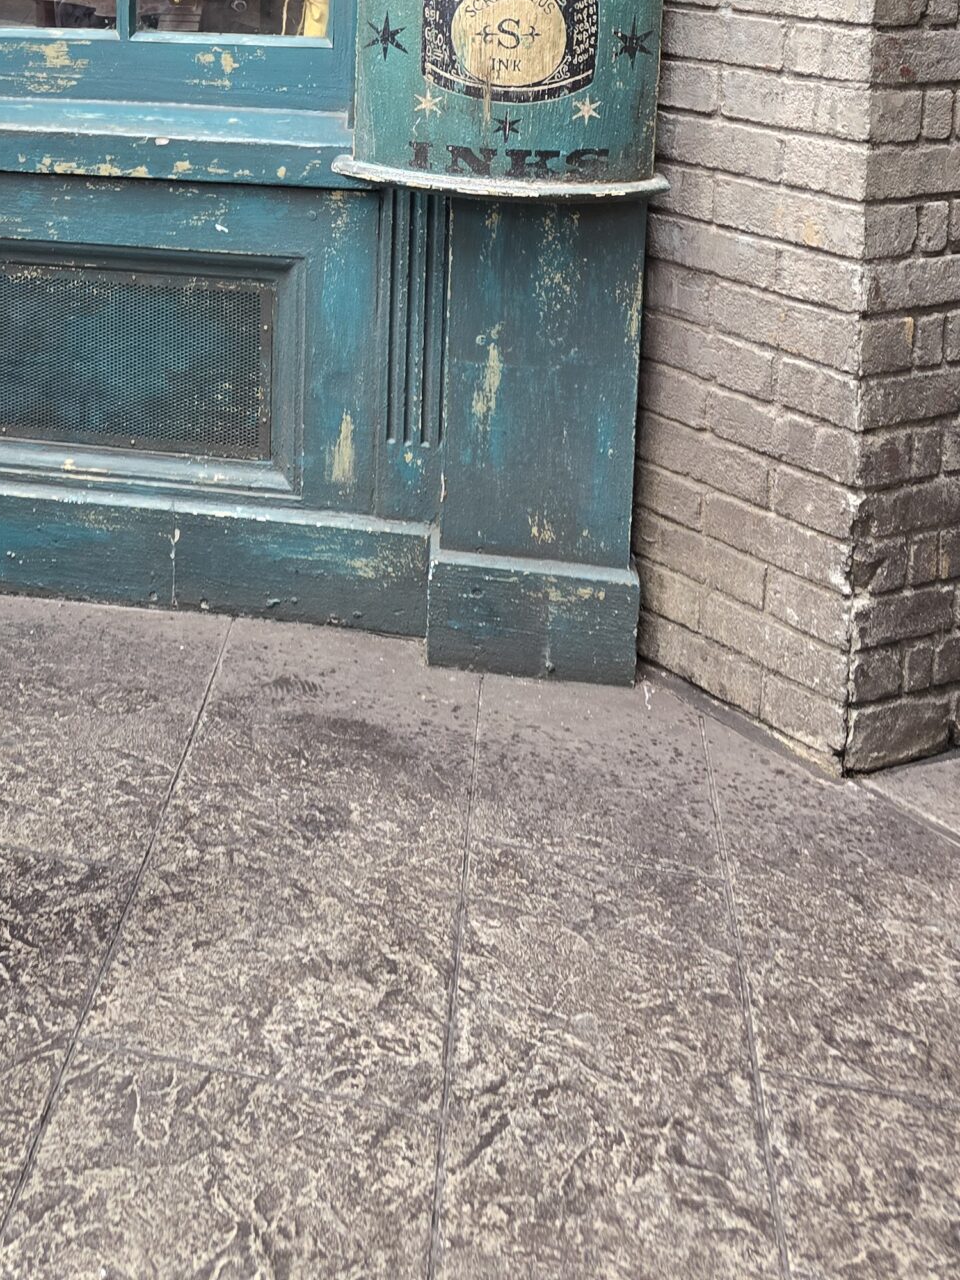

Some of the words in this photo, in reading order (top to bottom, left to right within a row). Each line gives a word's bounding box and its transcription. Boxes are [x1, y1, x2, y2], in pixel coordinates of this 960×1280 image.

[497, 18, 521, 49] S
[491, 57, 522, 72] INK
[408, 140, 610, 178] INKS
